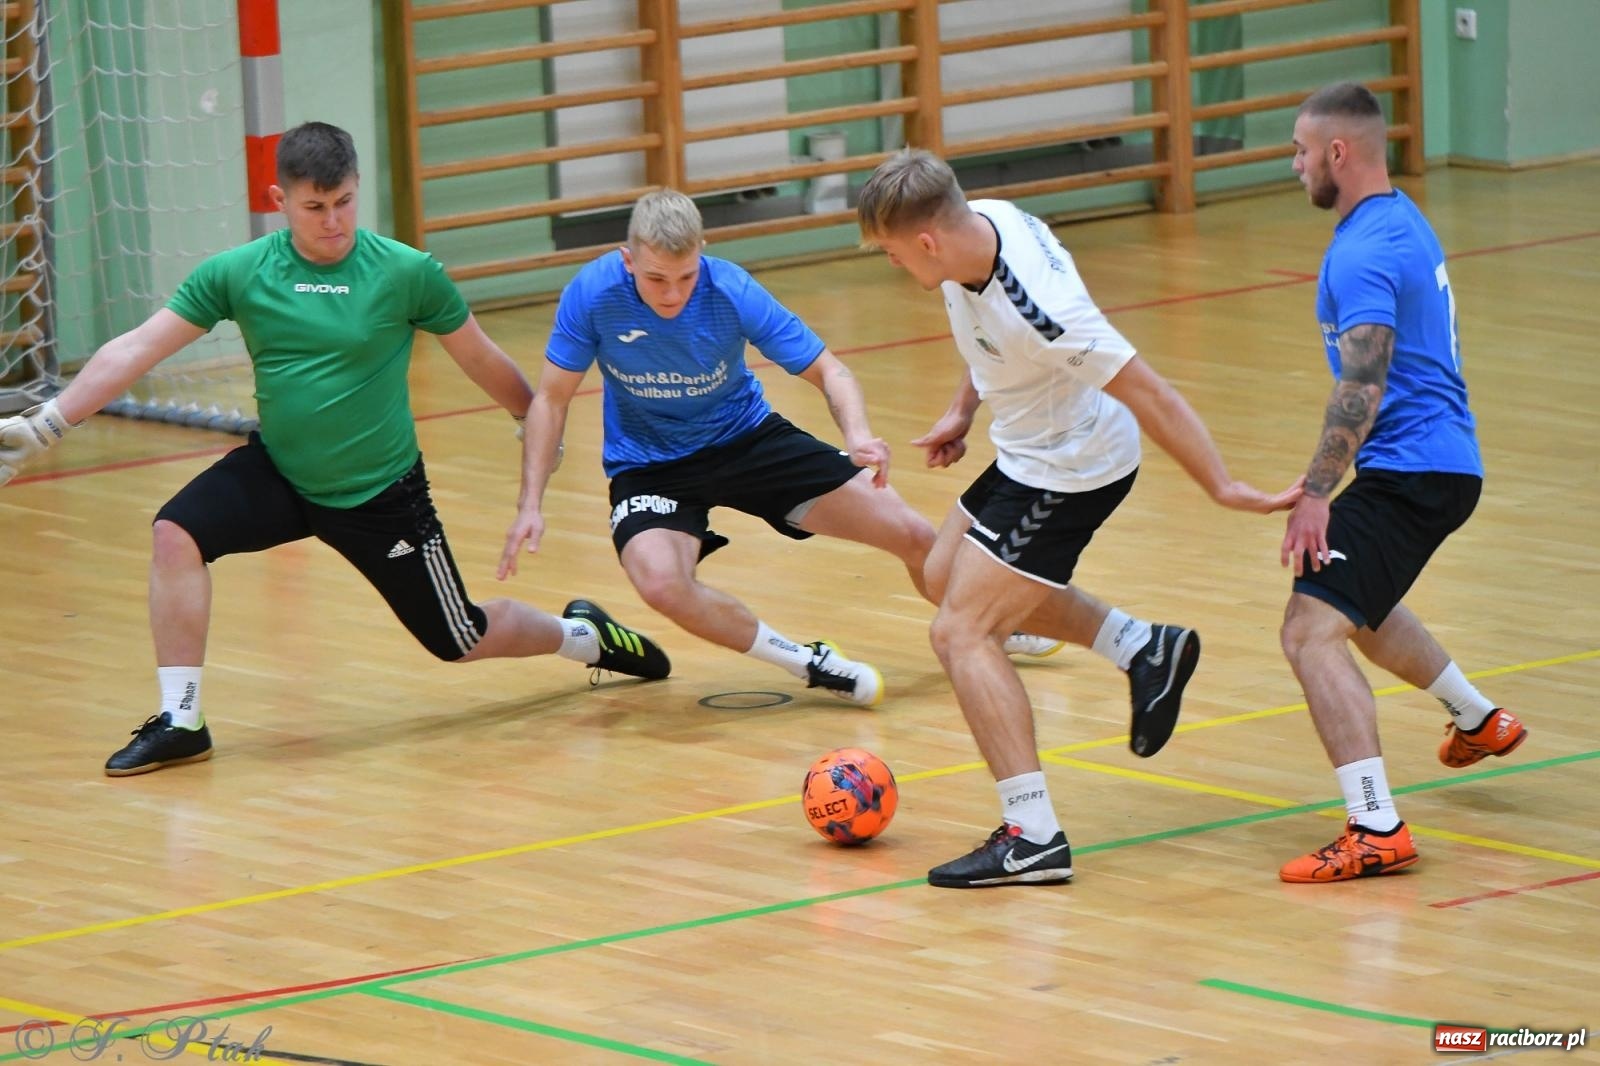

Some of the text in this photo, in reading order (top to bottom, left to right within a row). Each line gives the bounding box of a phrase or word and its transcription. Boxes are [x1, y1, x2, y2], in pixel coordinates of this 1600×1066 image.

[294, 283, 350, 295] GIVOVA
[629, 494, 678, 515] SPORT
[1007, 789, 1045, 806] SPORT
[808, 799, 849, 819] SELECT
